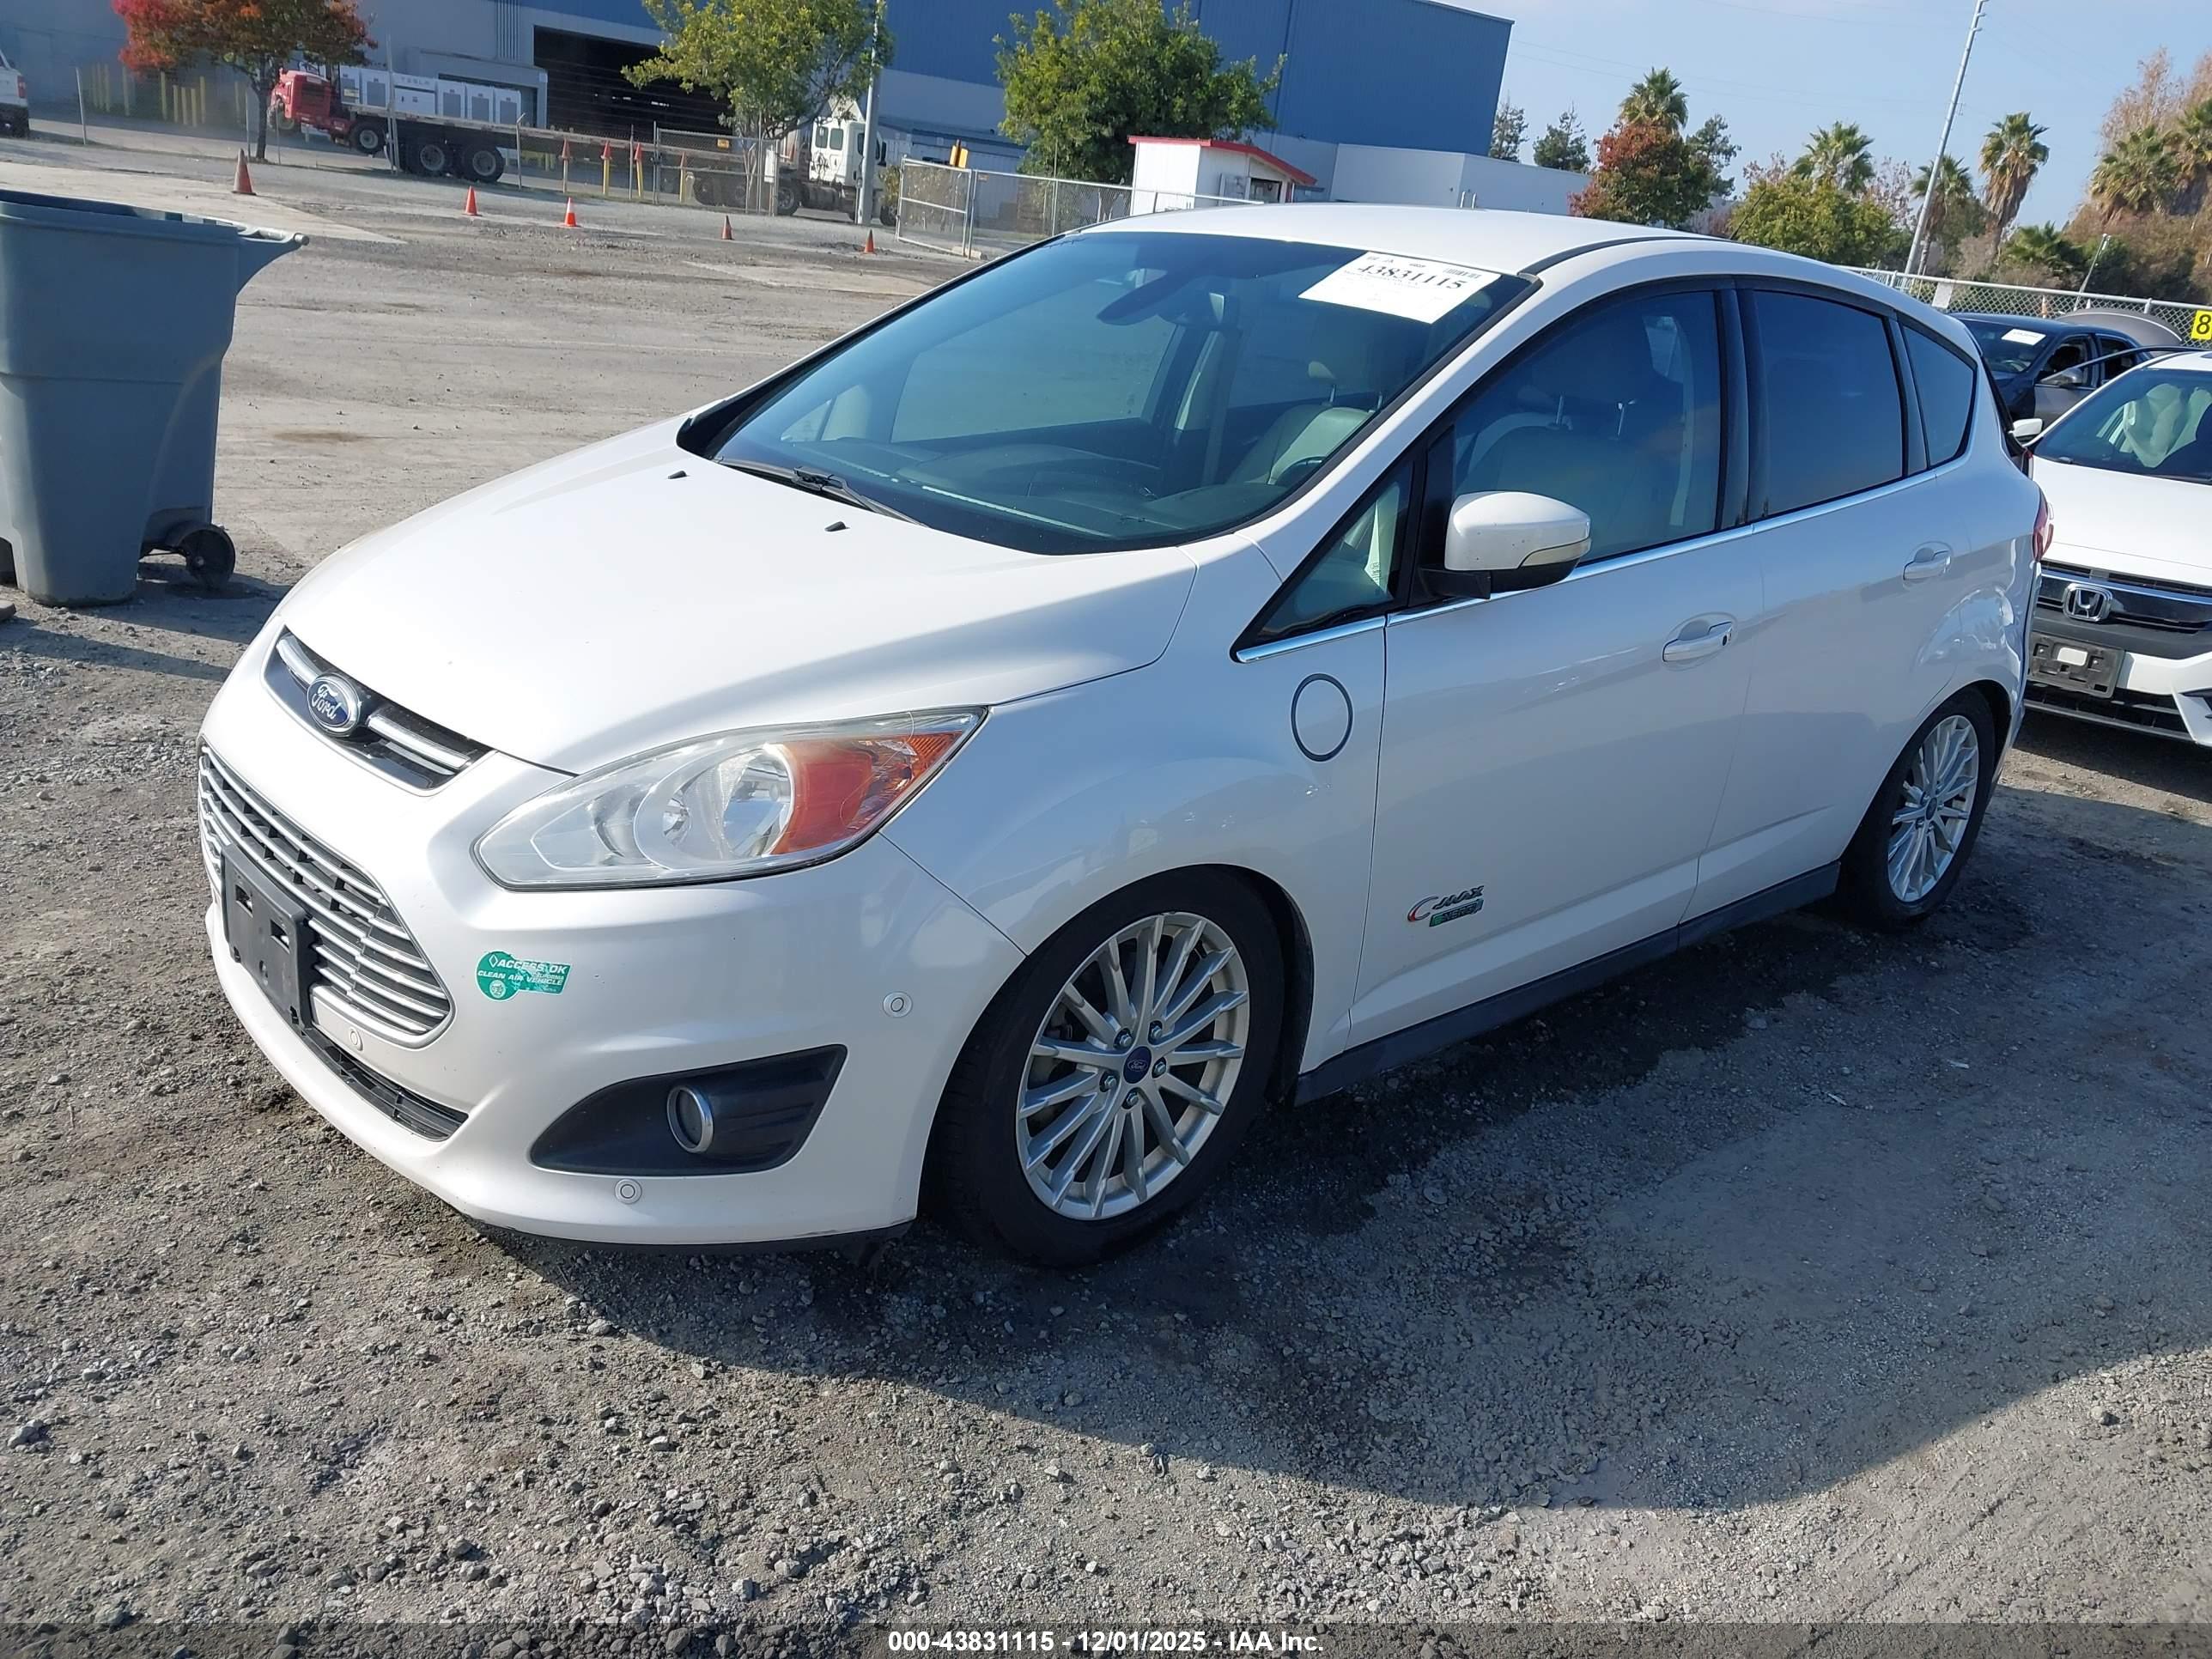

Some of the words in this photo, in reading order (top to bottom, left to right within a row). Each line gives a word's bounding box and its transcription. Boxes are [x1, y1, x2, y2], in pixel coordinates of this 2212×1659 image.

[1357, 264, 1468, 289] 43831115
[2196, 313, 2212, 335] 8
[311, 684, 343, 720] Ford
[497, 958, 546, 972] ACCESS
[549, 963, 568, 974] OK
[477, 969, 507, 980] CLEAN
[526, 975, 564, 986] VEHICLE
